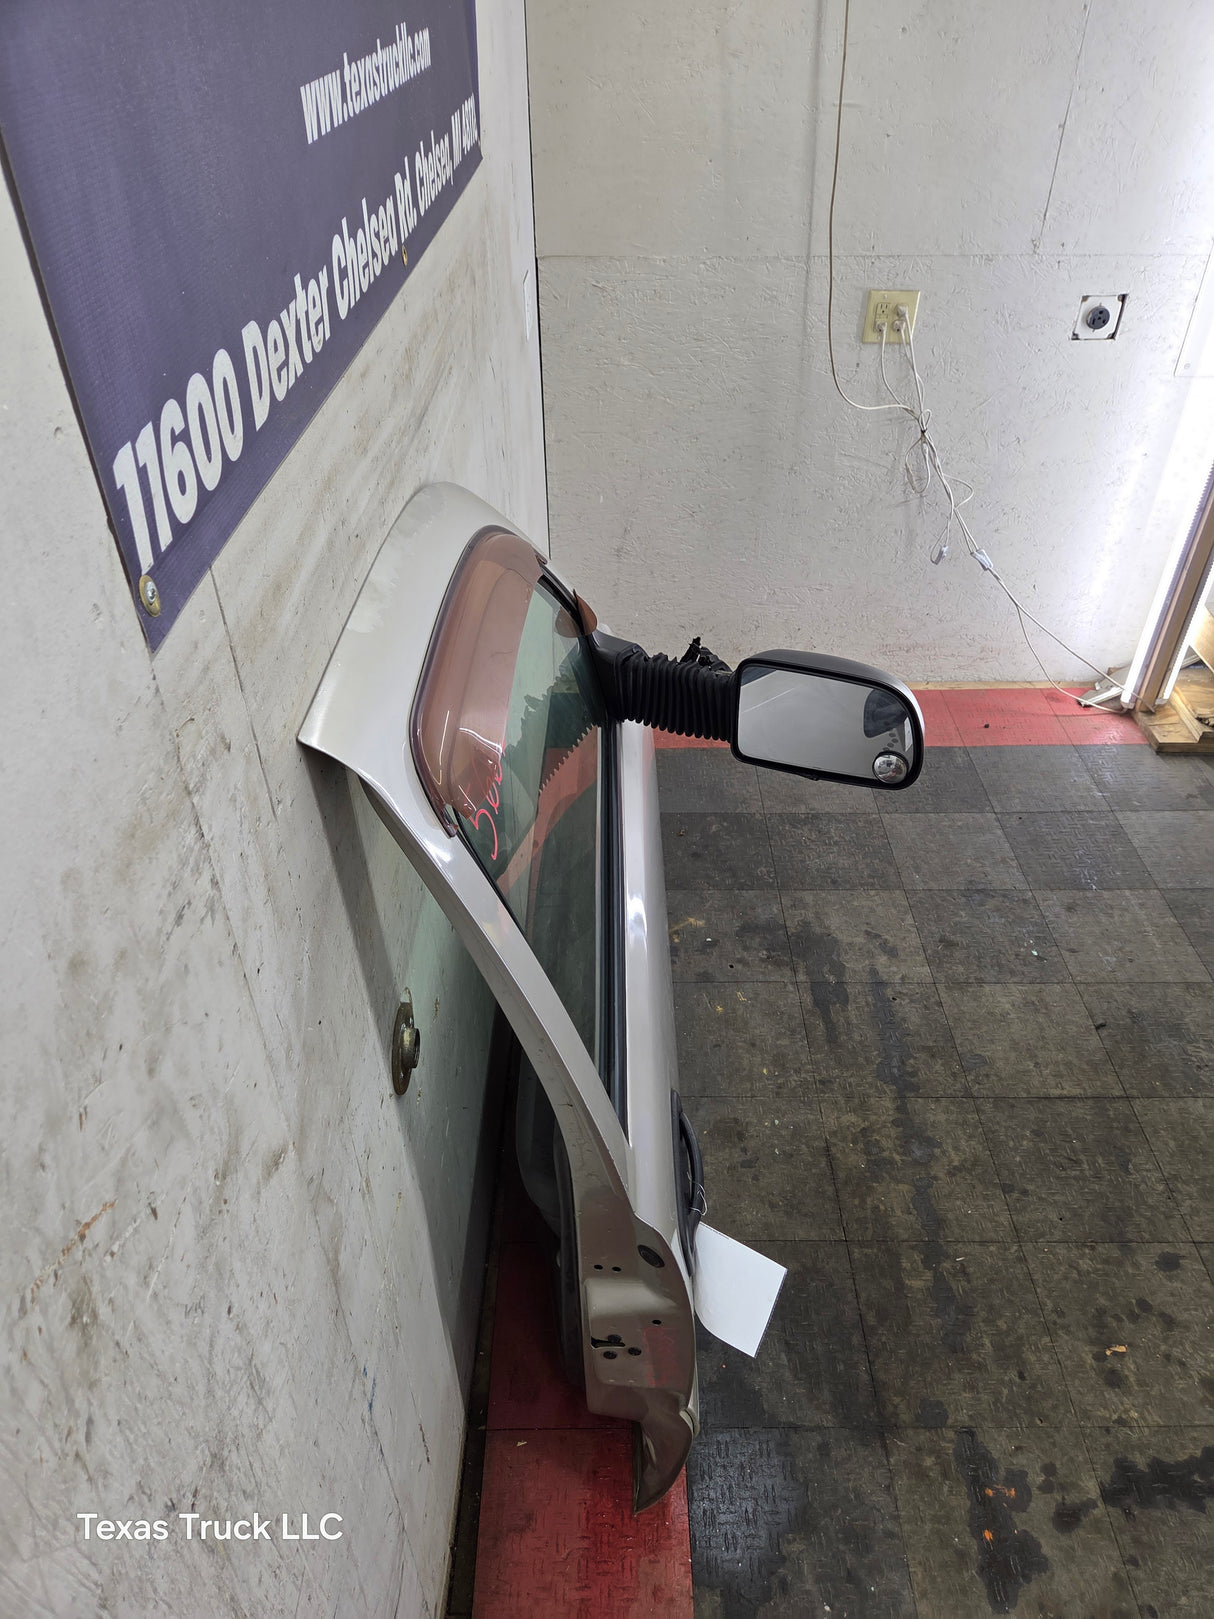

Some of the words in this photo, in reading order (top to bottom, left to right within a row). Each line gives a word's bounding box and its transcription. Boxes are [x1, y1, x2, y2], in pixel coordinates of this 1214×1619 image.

[301, 22, 431, 143] www.texastruckllc.com
[112, 349, 243, 574] 11600
[241, 265, 331, 432] Dexter
[331, 198, 398, 321] Chelsea
[394, 156, 417, 244] Rd.
[415, 129, 454, 217] Chelsea,
[451, 109, 462, 169] MI
